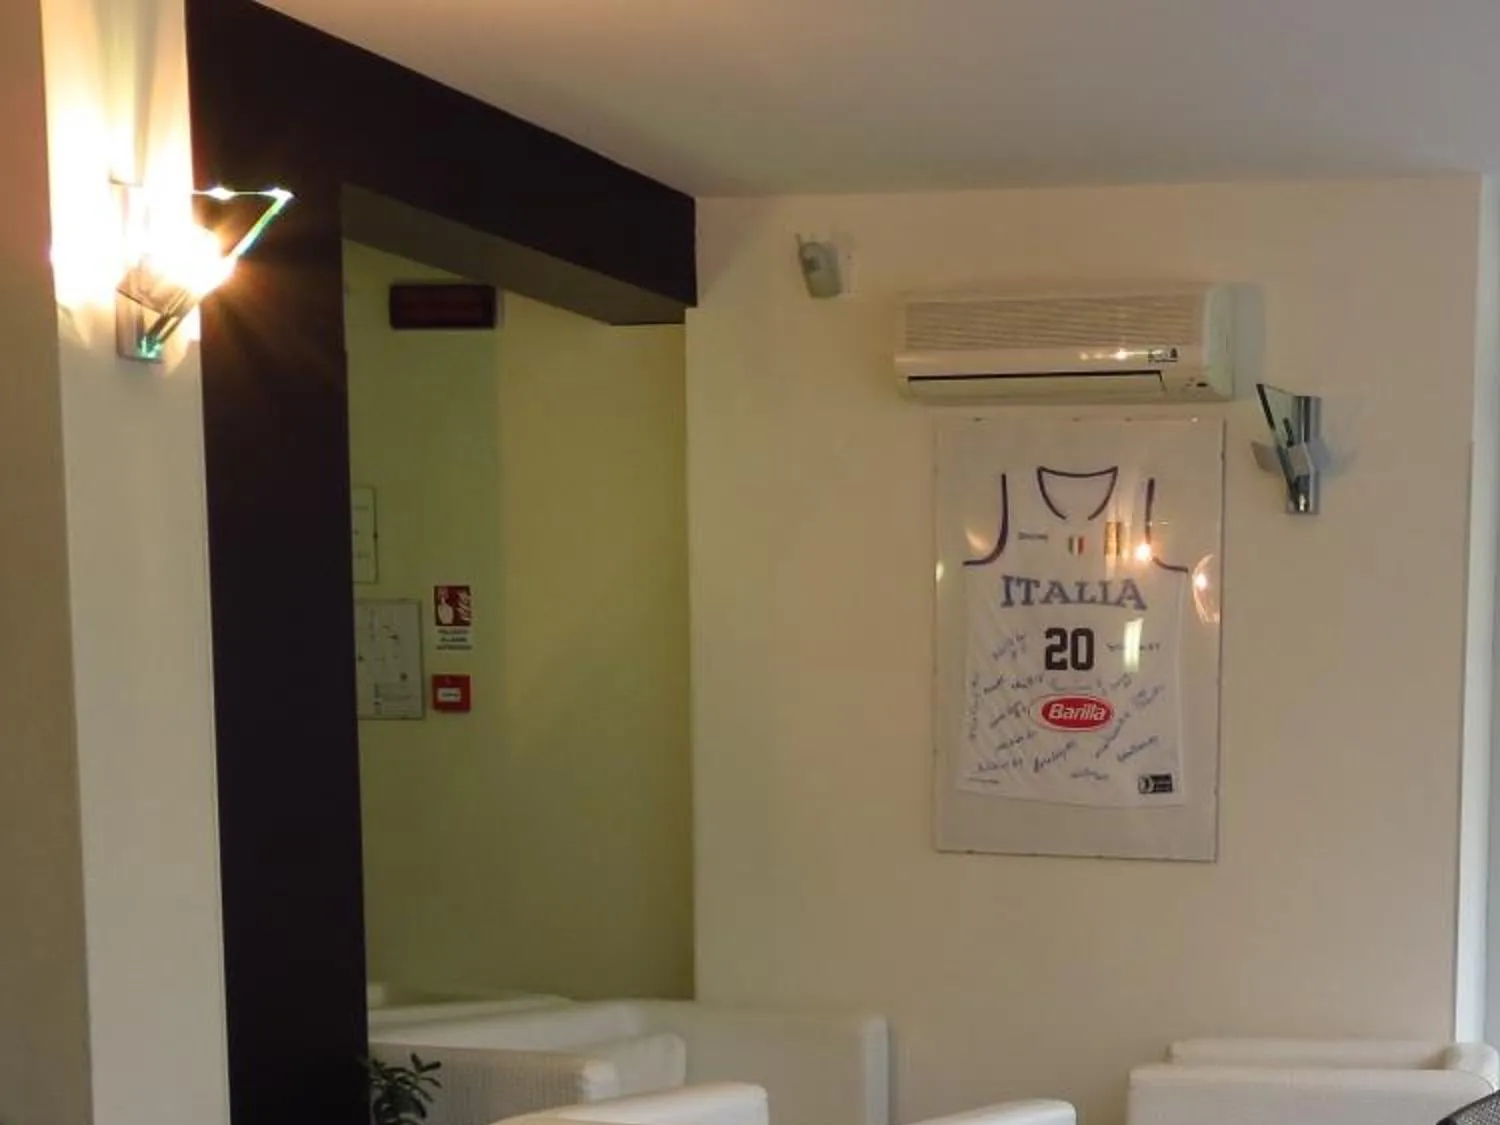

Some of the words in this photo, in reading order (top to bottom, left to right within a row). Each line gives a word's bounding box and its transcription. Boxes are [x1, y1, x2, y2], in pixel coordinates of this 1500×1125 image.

[1001, 574, 1147, 610] ITALIA
[1044, 627, 1095, 671] 20
[1048, 702, 1107, 721] Barilla
